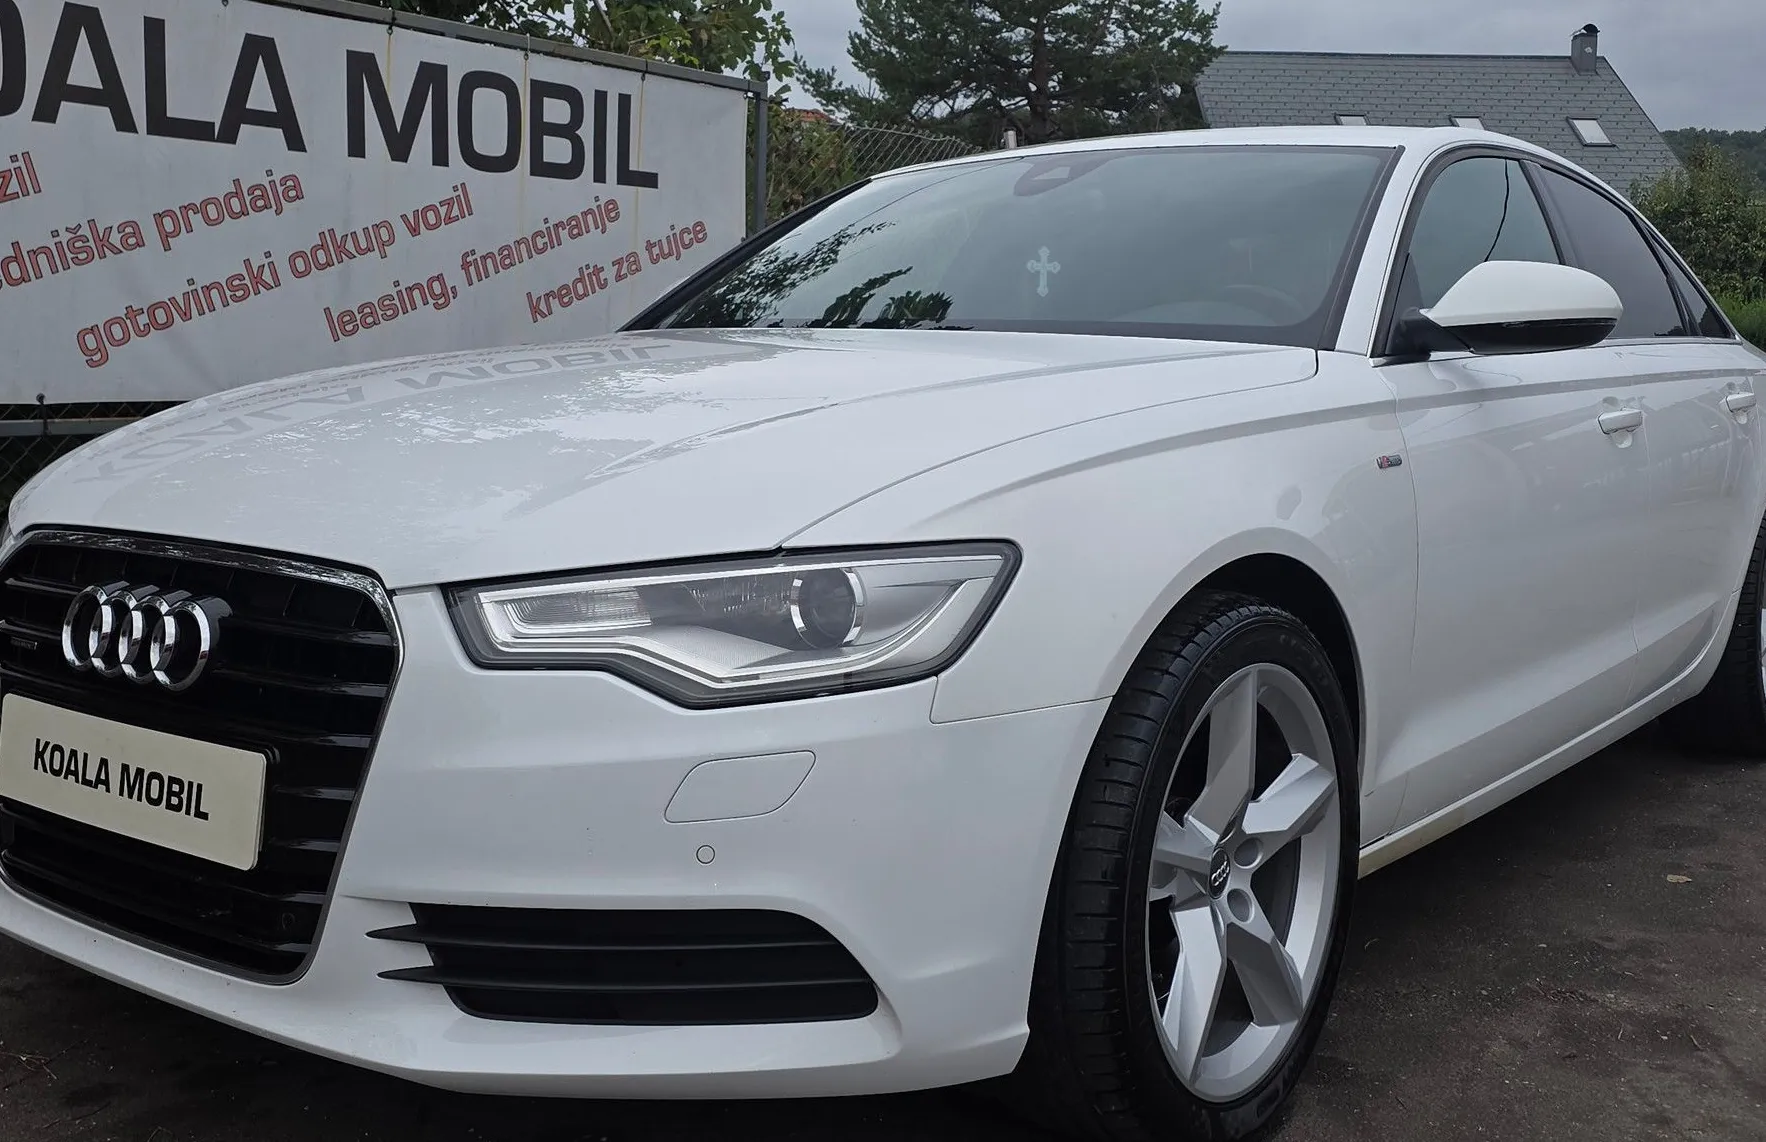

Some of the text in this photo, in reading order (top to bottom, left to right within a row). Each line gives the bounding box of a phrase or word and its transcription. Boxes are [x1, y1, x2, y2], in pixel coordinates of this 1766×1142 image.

[346, 48, 658, 189] MOBIL
[0, 169, 304, 290] dniška prodaja
[76, 182, 473, 368] gotovinski odkup vozil
[324, 195, 621, 342] leasing, financiranje
[526, 218, 708, 323] kredit za tujce
[33, 738, 209, 821] KOALA MOBIL
